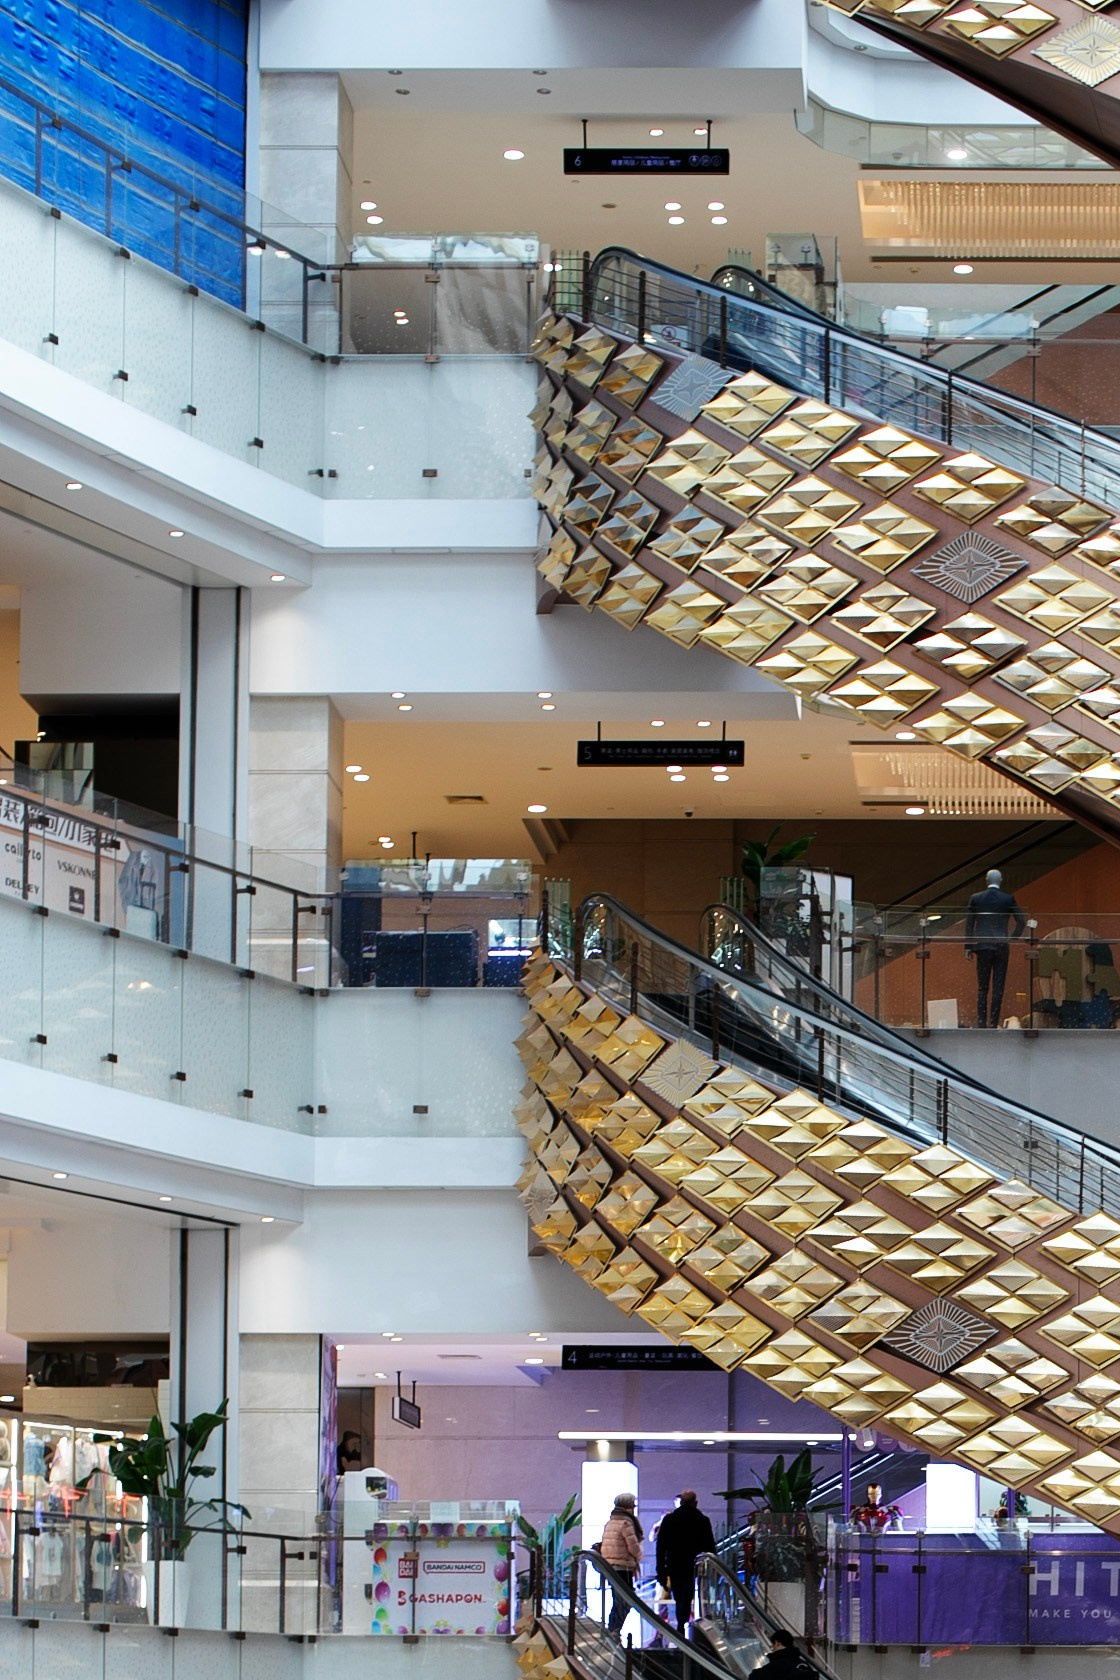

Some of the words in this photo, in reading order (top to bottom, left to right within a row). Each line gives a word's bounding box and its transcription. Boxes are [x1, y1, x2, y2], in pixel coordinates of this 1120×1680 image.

[574, 155, 582, 167] 6
[584, 746, 592, 760] 5
[5, 842, 42, 861] callto
[5, 877, 40, 895] DELEY
[568, 1351, 577, 1364] 4
[409, 1593, 483, 1603] GASHAPON
[1028, 1608, 1072, 1619] MAKE
[1081, 1608, 1112, 1619] YOU
